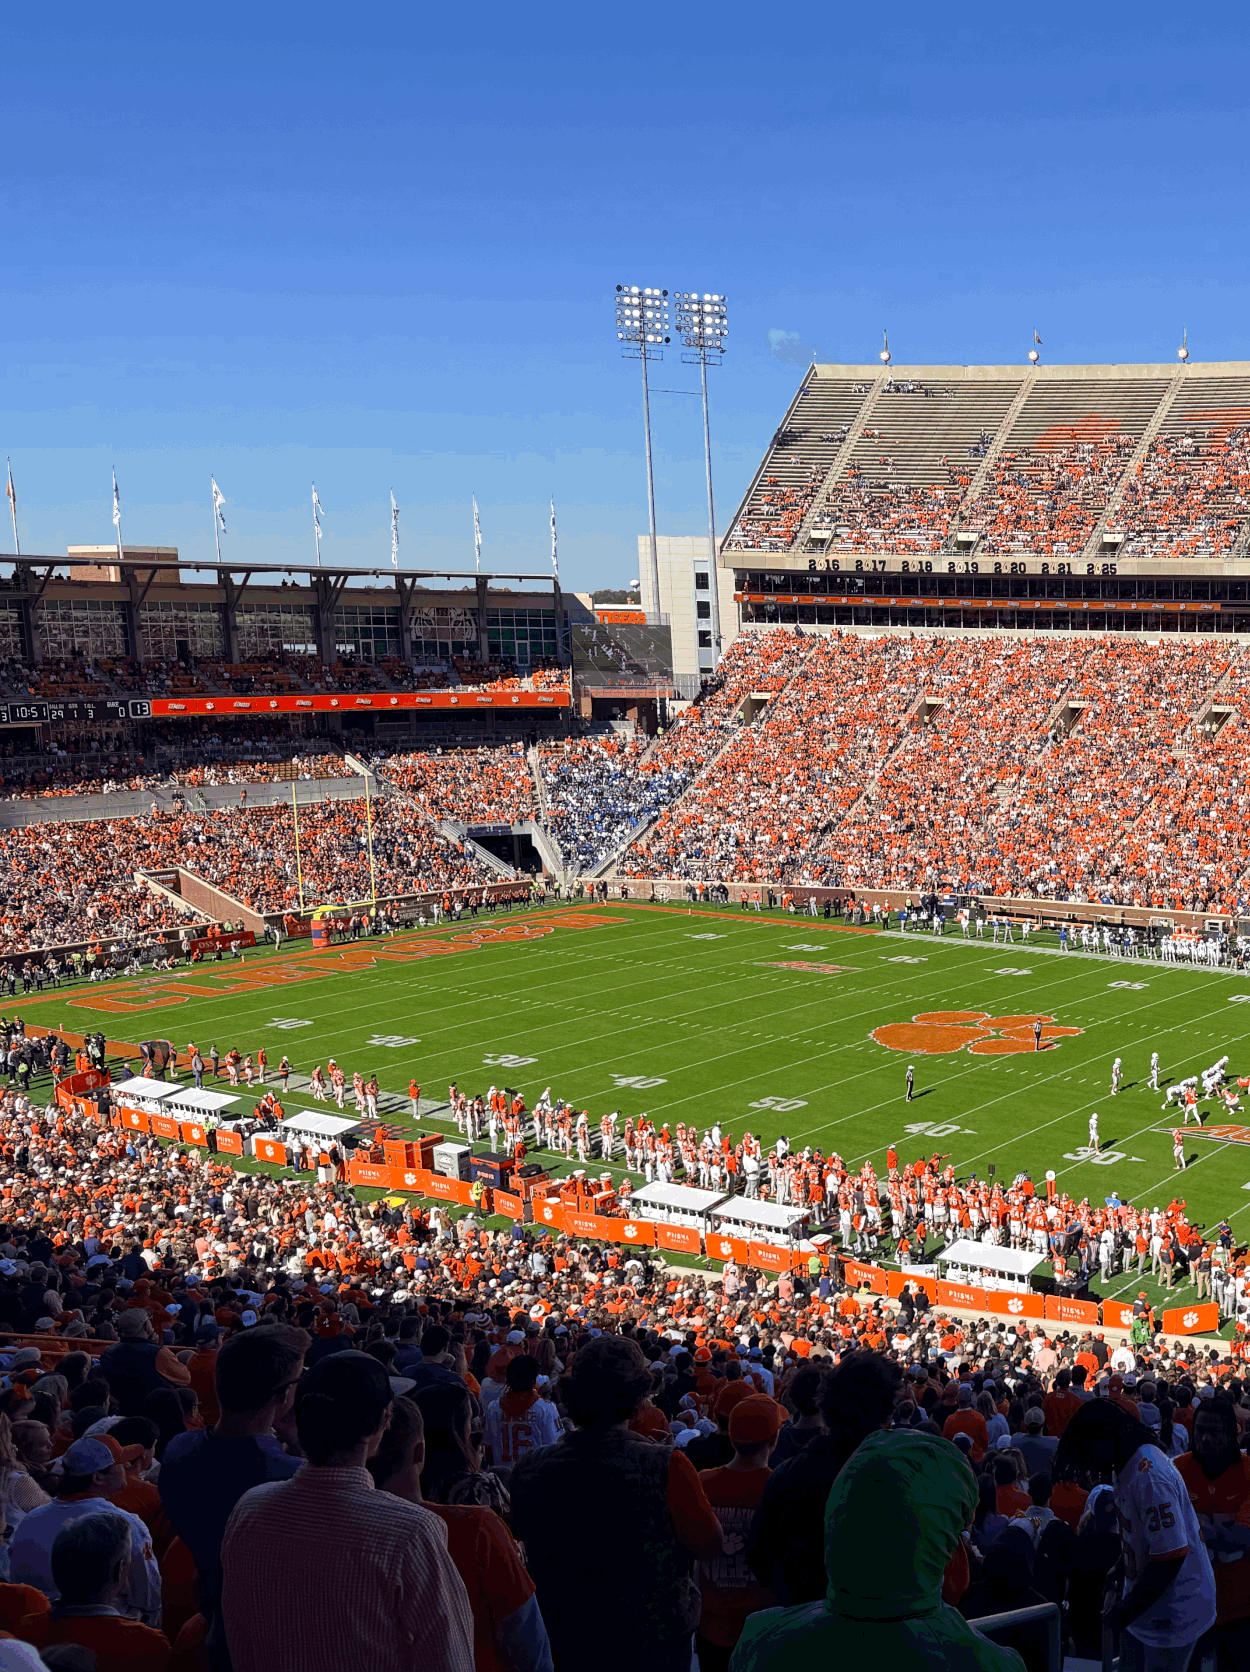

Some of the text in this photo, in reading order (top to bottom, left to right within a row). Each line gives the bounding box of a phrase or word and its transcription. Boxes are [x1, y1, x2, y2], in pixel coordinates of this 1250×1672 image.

[596, 611, 646, 624] TIGERS
[16, 707, 46, 718] 10:51
[88, 710, 93, 718] 3
[119, 707, 125, 717] 0
[136, 702, 149, 714] 13
[51, 710, 63, 719] 29
[1107, 980, 1150, 990] 50
[366, 1035, 421, 1048] 20
[482, 1054, 539, 1068] 30
[613, 1075, 668, 1089] 40
[748, 1096, 809, 1112] 50
[904, 1121, 962, 1137] 40
[1062, 1146, 1127, 1165] 30
[574, 1219, 597, 1229] PRISMA
[666, 1231, 690, 1241] PRISMA
[758, 1250, 781, 1261] PRISMA
[949, 1290, 974, 1302] PRISMA
[1057, 1305, 1085, 1316] PRISMA
[501, 1423, 532, 1461] 16
[1146, 1502, 1175, 1531] 35
